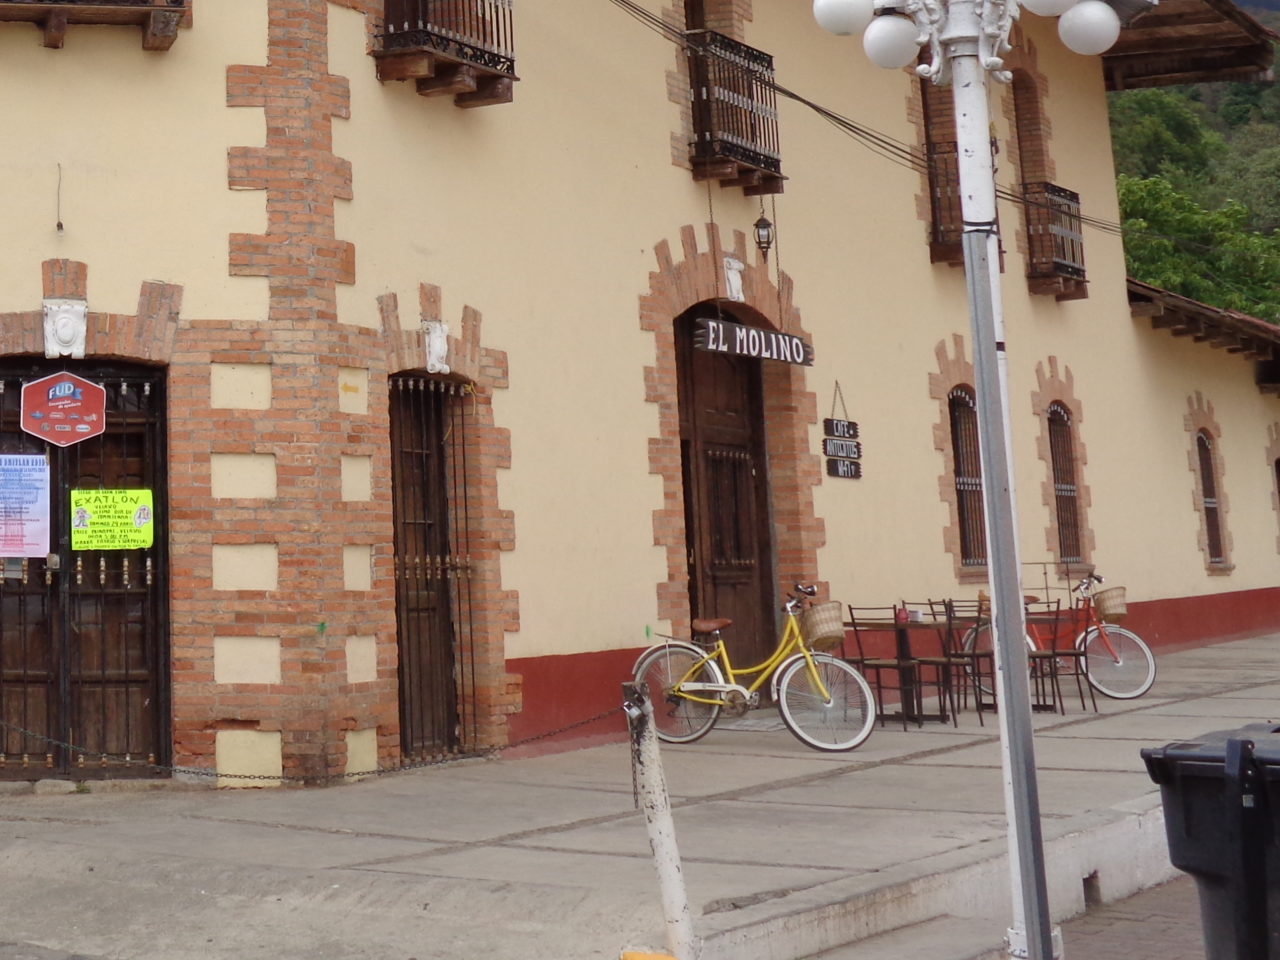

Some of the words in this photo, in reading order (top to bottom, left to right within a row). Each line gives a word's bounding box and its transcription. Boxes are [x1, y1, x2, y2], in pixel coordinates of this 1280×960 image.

[708, 321, 728, 352] EL
[736, 327, 804, 363] MOLINO
[49, 383, 74, 399] FUD
[74, 495, 140, 507] EXATLON
